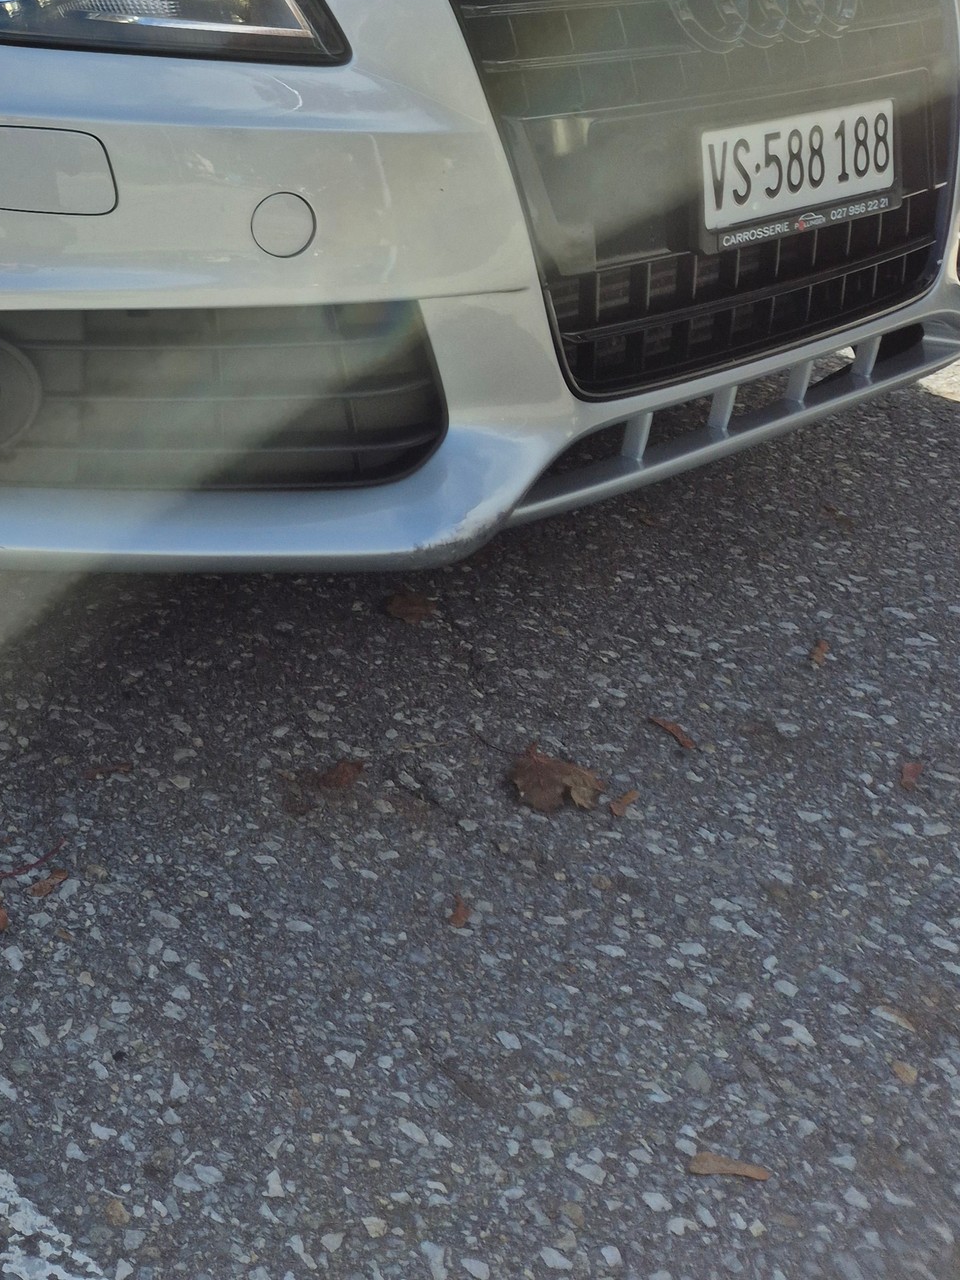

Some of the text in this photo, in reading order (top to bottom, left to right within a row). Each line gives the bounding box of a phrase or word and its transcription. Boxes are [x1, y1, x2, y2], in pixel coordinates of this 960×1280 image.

[722, 221, 790, 247] CARROSSERIE
[830, 207, 847, 220] 027
[848, 202, 866, 216] 956
[867, 200, 879, 211] 22
[880, 197, 889, 209] 21
